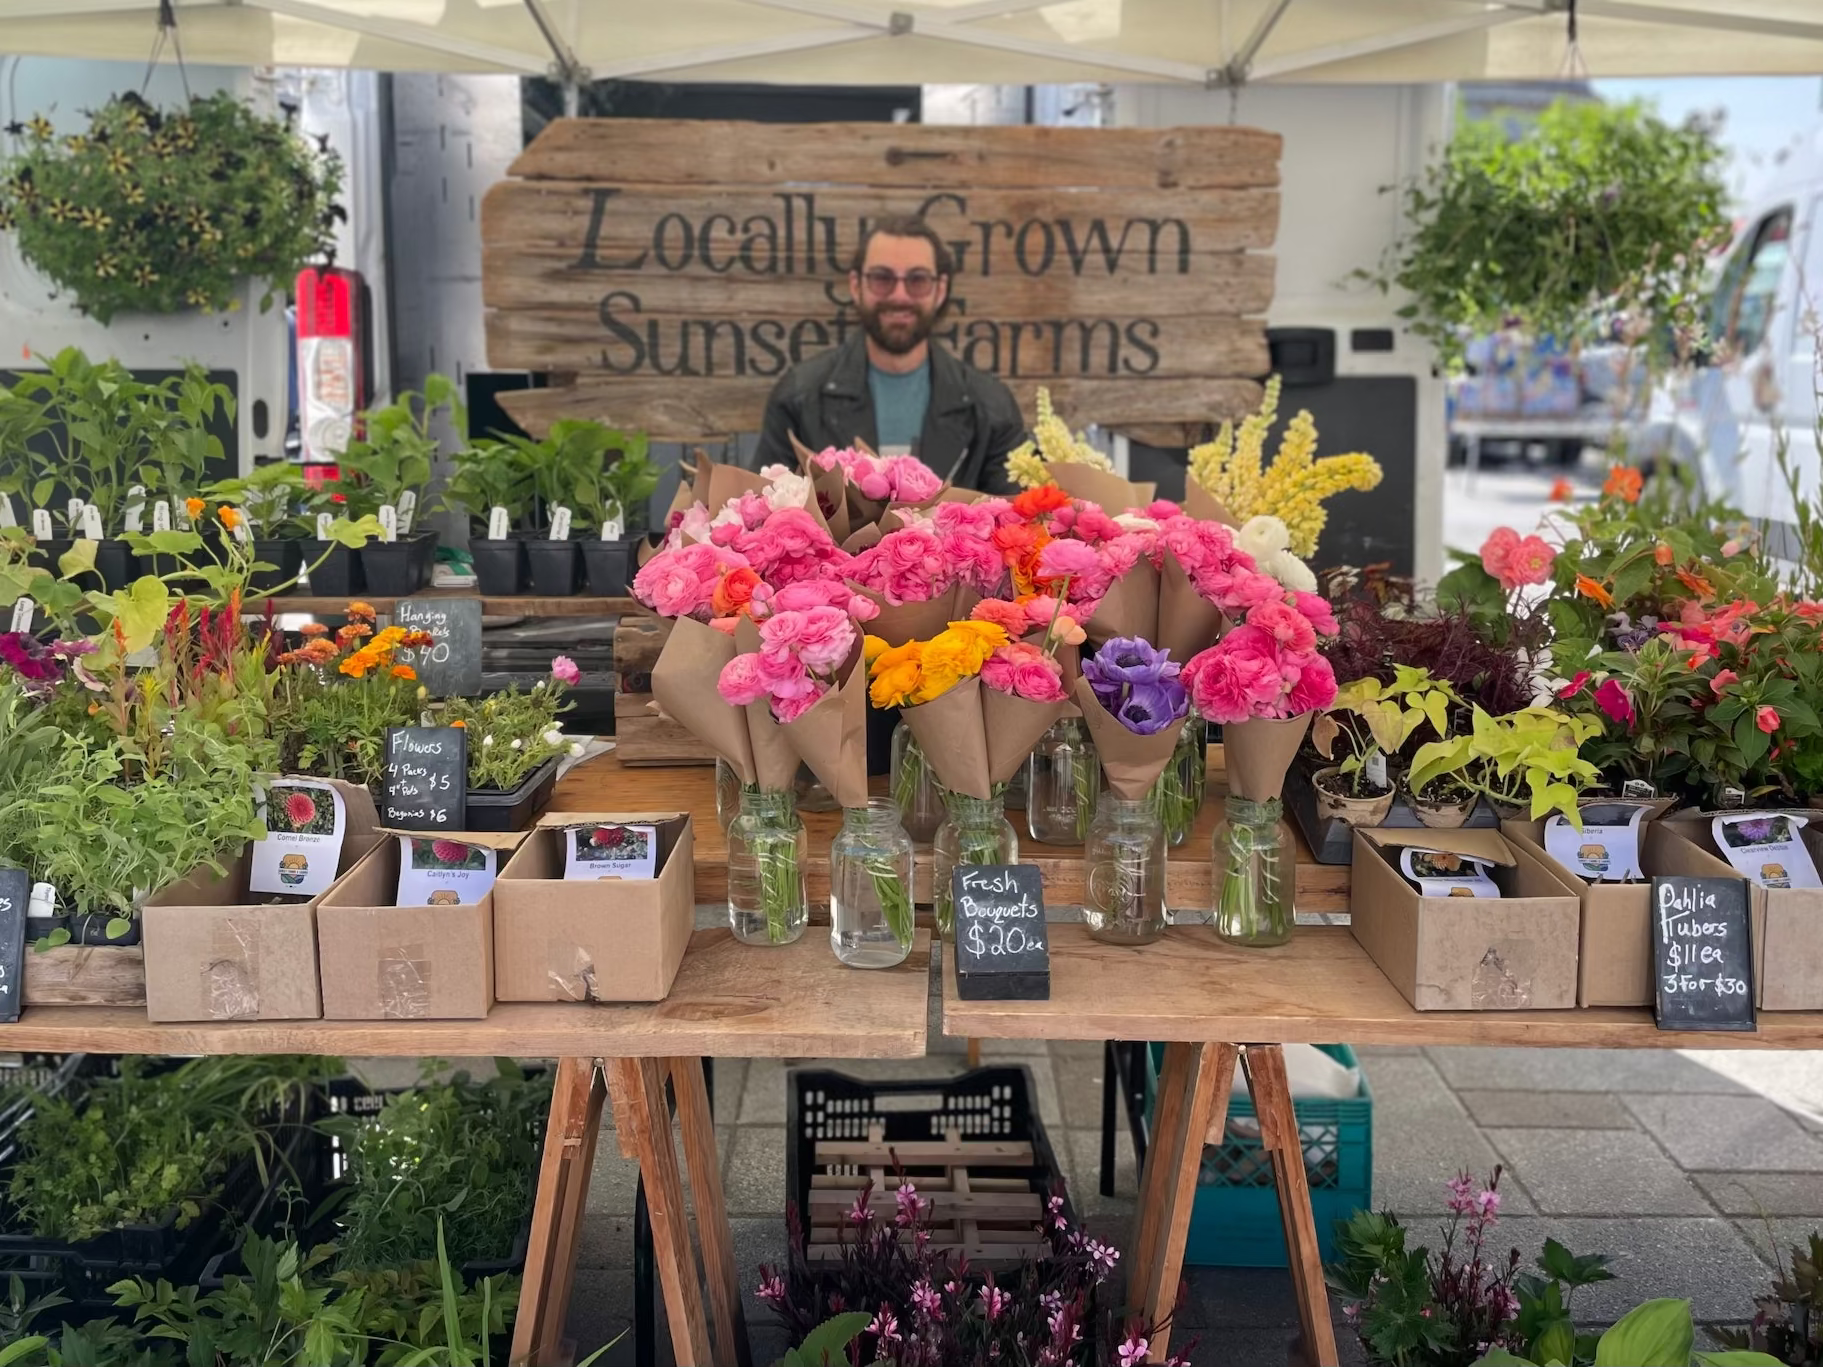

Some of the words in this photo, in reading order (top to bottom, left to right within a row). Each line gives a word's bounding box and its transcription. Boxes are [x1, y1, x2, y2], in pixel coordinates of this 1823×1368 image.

[566, 188, 867, 307] Locally
[599, 291, 859, 377] Sunset
[400, 604, 447, 625] Hanging
[401, 642, 449, 666] $40
[392, 729, 442, 755] Flowers
[388, 762, 399, 778] 4
[402, 763, 427, 777] Packs
[387, 806, 425, 821] Begonias
[430, 808, 448, 823] $6
[457, 871, 470, 880] Joy
[589, 862, 611, 870] Brown
[612, 862, 632, 870] Sugar
[962, 870, 1018, 894] Fresh
[960, 892, 1038, 924] Bouquets
[1664, 910, 1728, 938] Tubers
